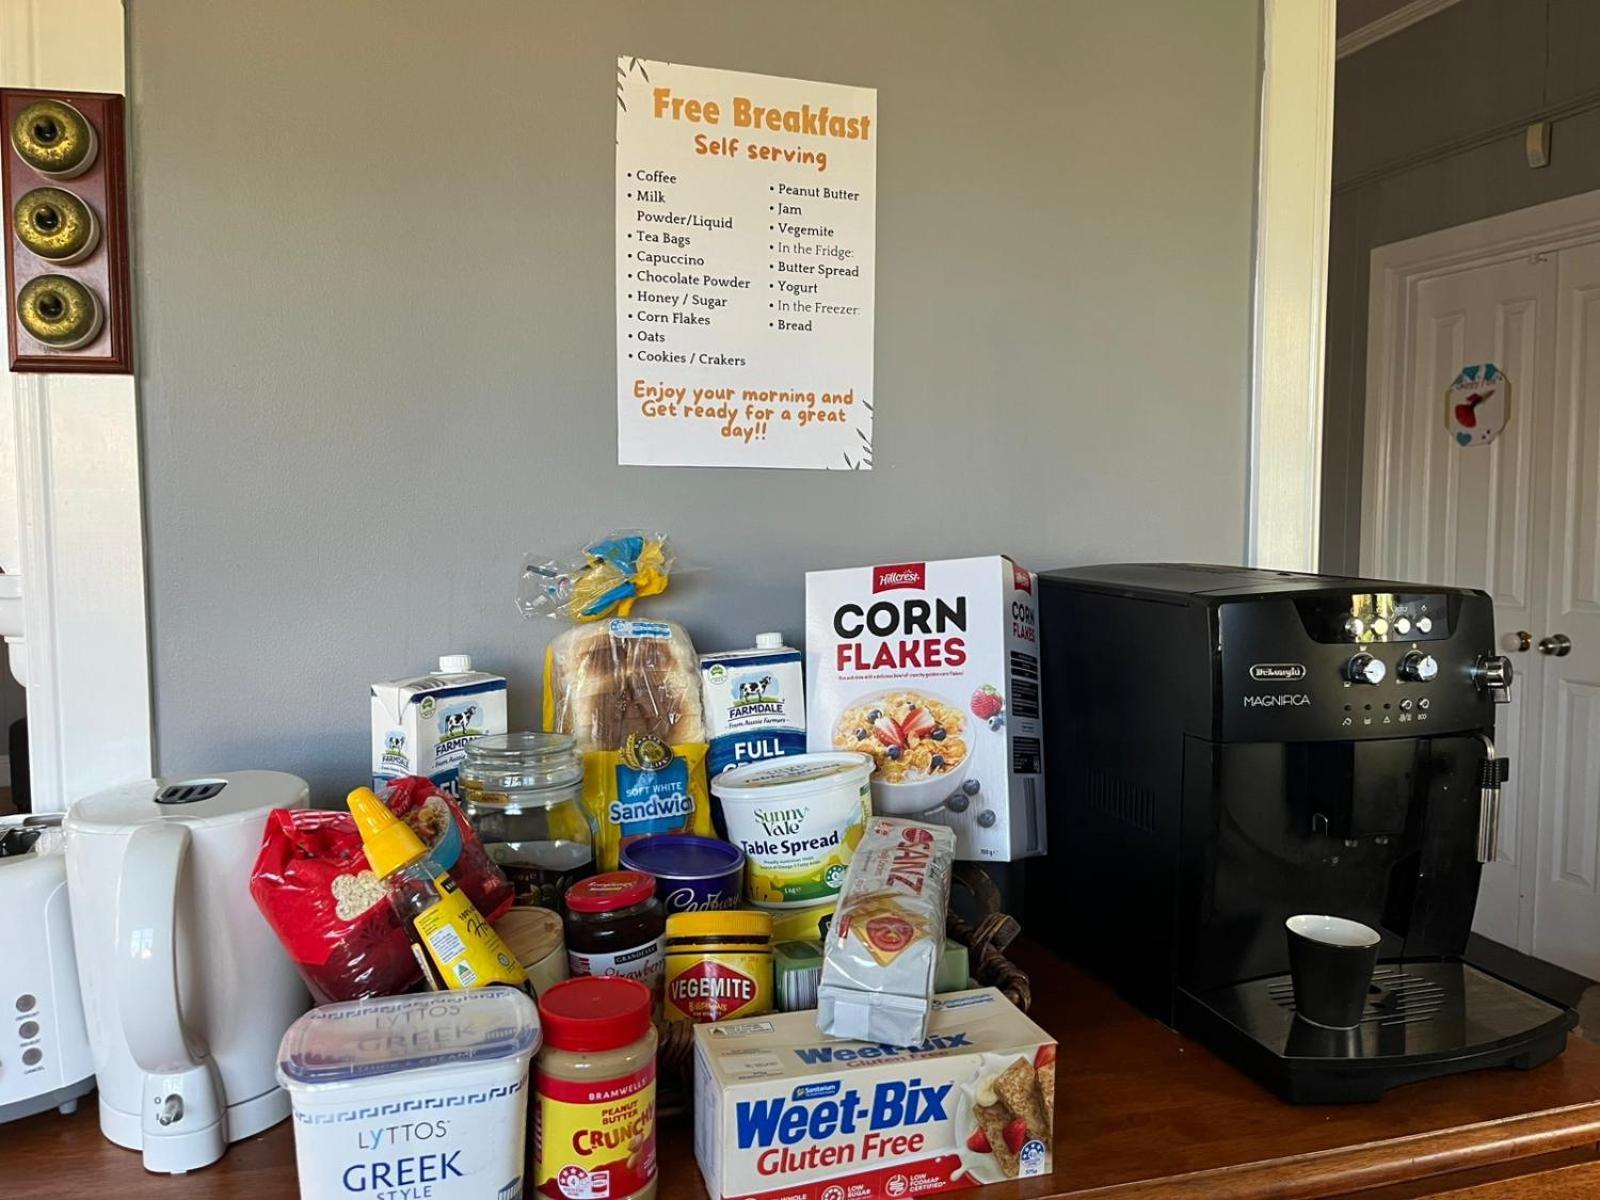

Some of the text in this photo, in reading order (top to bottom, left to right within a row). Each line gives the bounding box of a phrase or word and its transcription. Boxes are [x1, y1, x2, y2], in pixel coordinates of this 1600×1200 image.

[653, 87, 871, 141] Free Breakfast
[694, 133, 828, 172] Self serving
[636, 169, 677, 184] Coffee
[637, 190, 666, 203] Milk
[778, 184, 860, 201] Peanut Butter
[778, 203, 802, 216] Jam
[637, 210, 733, 229] Powder/Liquid
[778, 223, 835, 238] Vegemite
[637, 231, 691, 248] Tea Bags
[637, 251, 705, 266] Capuccino
[778, 242, 855, 259] In the Fridge:
[778, 261, 860, 278] Butter Spread
[637, 271, 751, 289] Chocolate Powder
[778, 280, 818, 297] Yogurt
[637, 291, 728, 309] Honey / Sugar
[778, 301, 790, 312] In
[792, 301, 811, 313] the
[637, 311, 711, 326] Corn Flakes
[778, 320, 813, 332] Bread
[637, 331, 666, 343] Oats
[637, 350, 746, 367] Cookies / Crakers
[633, 379, 854, 408] Enjoy your morning and
[641, 400, 847, 426] Get ready for a great
[720, 422, 767, 443] day!!
[880, 570, 920, 586] Hillcrest
[833, 596, 967, 639] CORN
[837, 637, 967, 672] FLAKES
[1244, 694, 1310, 708] MAGNIFICA
[729, 704, 783, 718] FARMDALE
[734, 738, 785, 760] FULL
[626, 781, 683, 798] SOFT WHITE
[754, 807, 806, 824] Sunny
[761, 820, 800, 837] Vale
[741, 830, 839, 857] Table Spread
[671, 977, 751, 1000] VEGEMITE
[375, 1005, 460, 1030] LYTTOS
[355, 1026, 476, 1051] GREEK
[846, 1055, 906, 1068] Gluten
[588, 1078, 647, 1101] BRAMWELLS
[805, 1084, 836, 1093] Sanitarium
[602, 1100, 639, 1117] PEANUT
[602, 1108, 639, 1125] BUTTER
[736, 1078, 954, 1150] Weet-Bix
[358, 1120, 448, 1150] LYTTOS
[757, 1133, 925, 1176] Gluten Free
[343, 1150, 464, 1193] GREEK
[909, 1174, 927, 1182] LOW
[376, 1185, 432, 1200] STYLE
[847, 1184, 864, 1192] LOW
[847, 1189, 871, 1199] SUGAR
